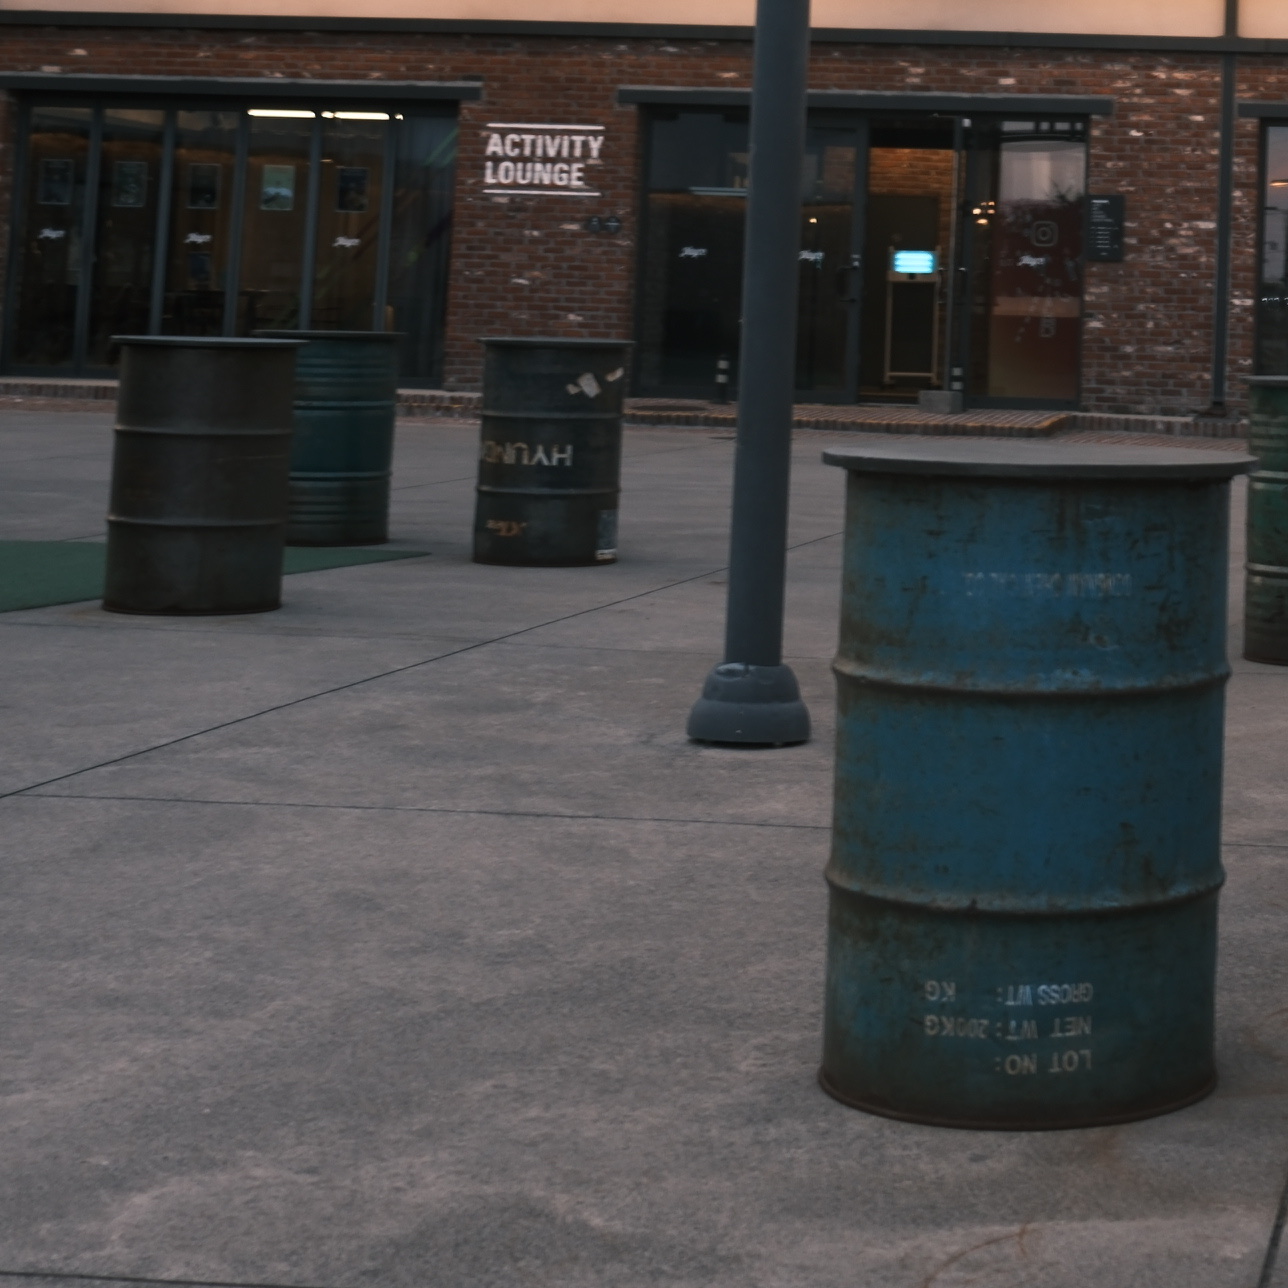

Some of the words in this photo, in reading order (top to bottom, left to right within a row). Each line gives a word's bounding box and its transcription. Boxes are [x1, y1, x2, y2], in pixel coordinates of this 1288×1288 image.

[485, 133, 605, 159] ACTIVITY
[484, 160, 586, 186] LOUNGE
[924, 979, 957, 1002] KG
[1037, 982, 1094, 1005] GROSS
[1048, 1015, 1093, 1039] NET
[1048, 1048, 1093, 1074] LOT
